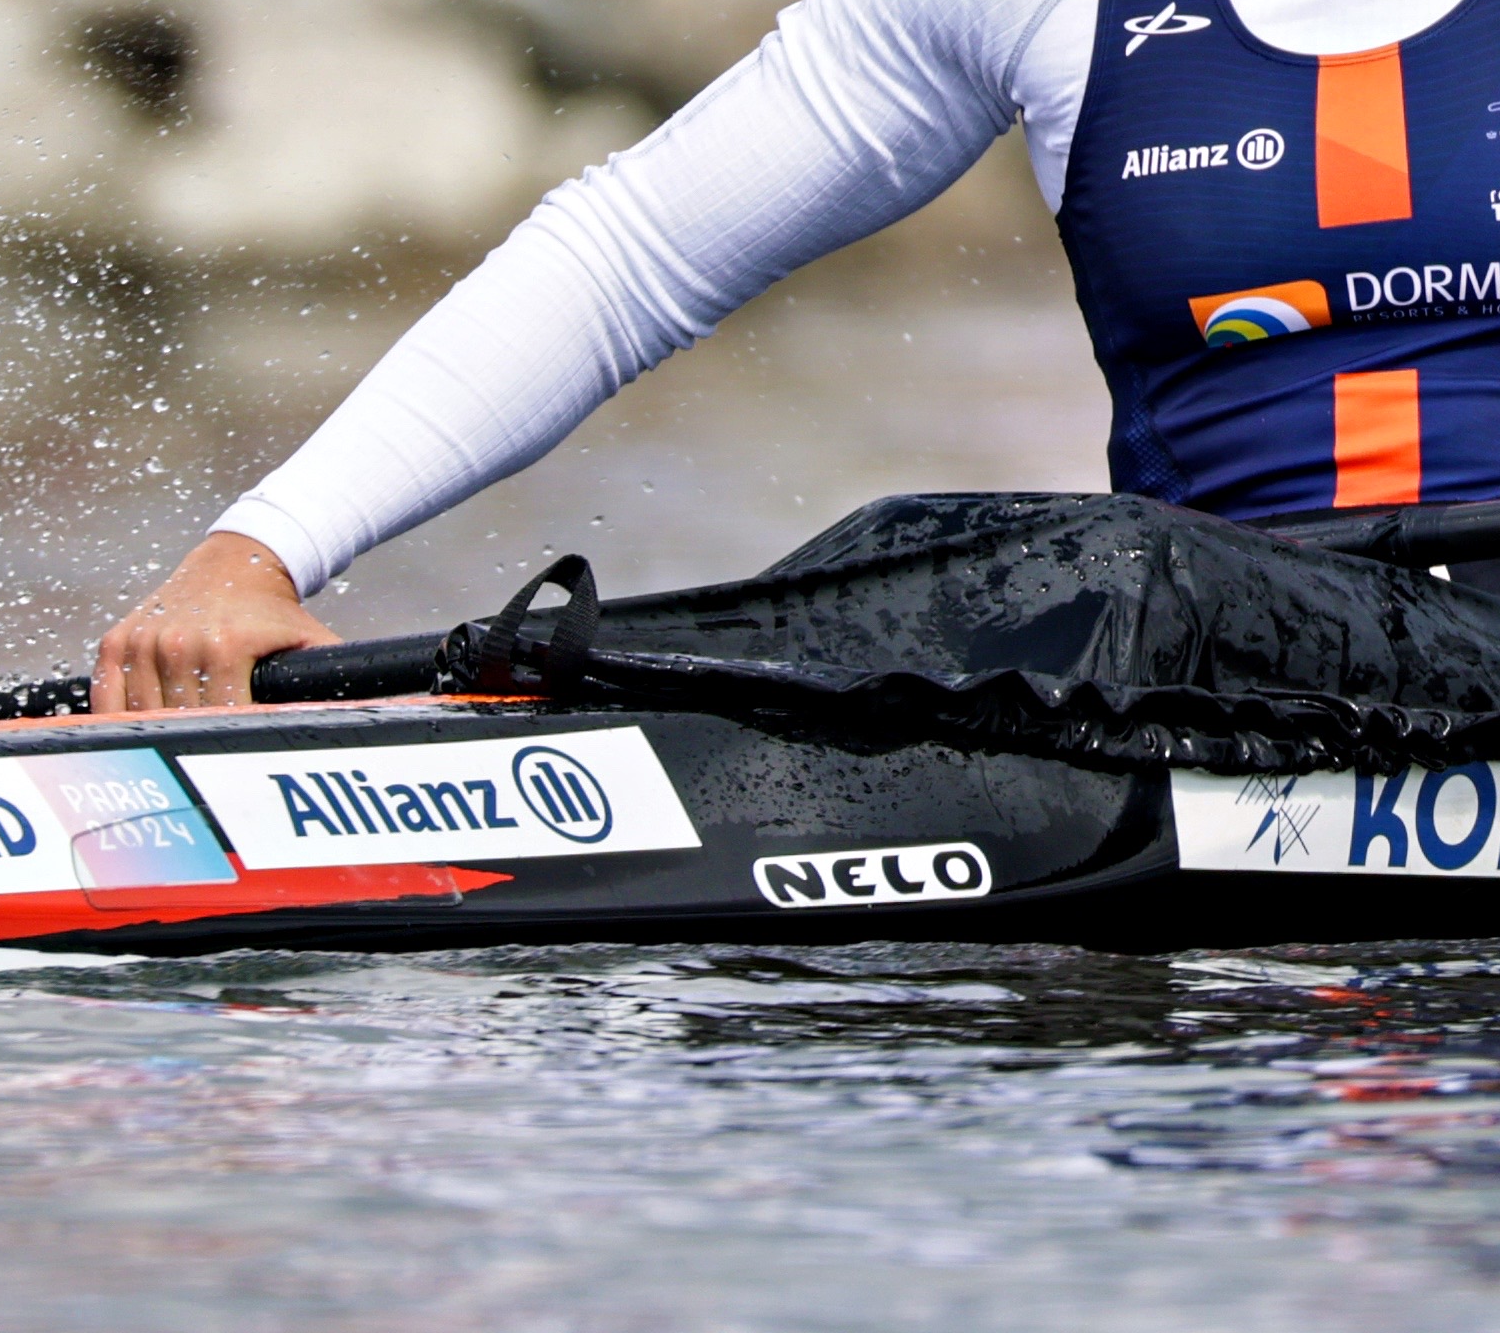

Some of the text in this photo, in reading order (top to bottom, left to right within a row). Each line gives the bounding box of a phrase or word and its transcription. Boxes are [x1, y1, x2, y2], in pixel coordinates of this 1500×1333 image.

[1121, 144, 1230, 180] Allianz
[267, 769, 520, 838] Allianz
[86, 814, 196, 851] 2024
[763, 849, 984, 903] NELO
